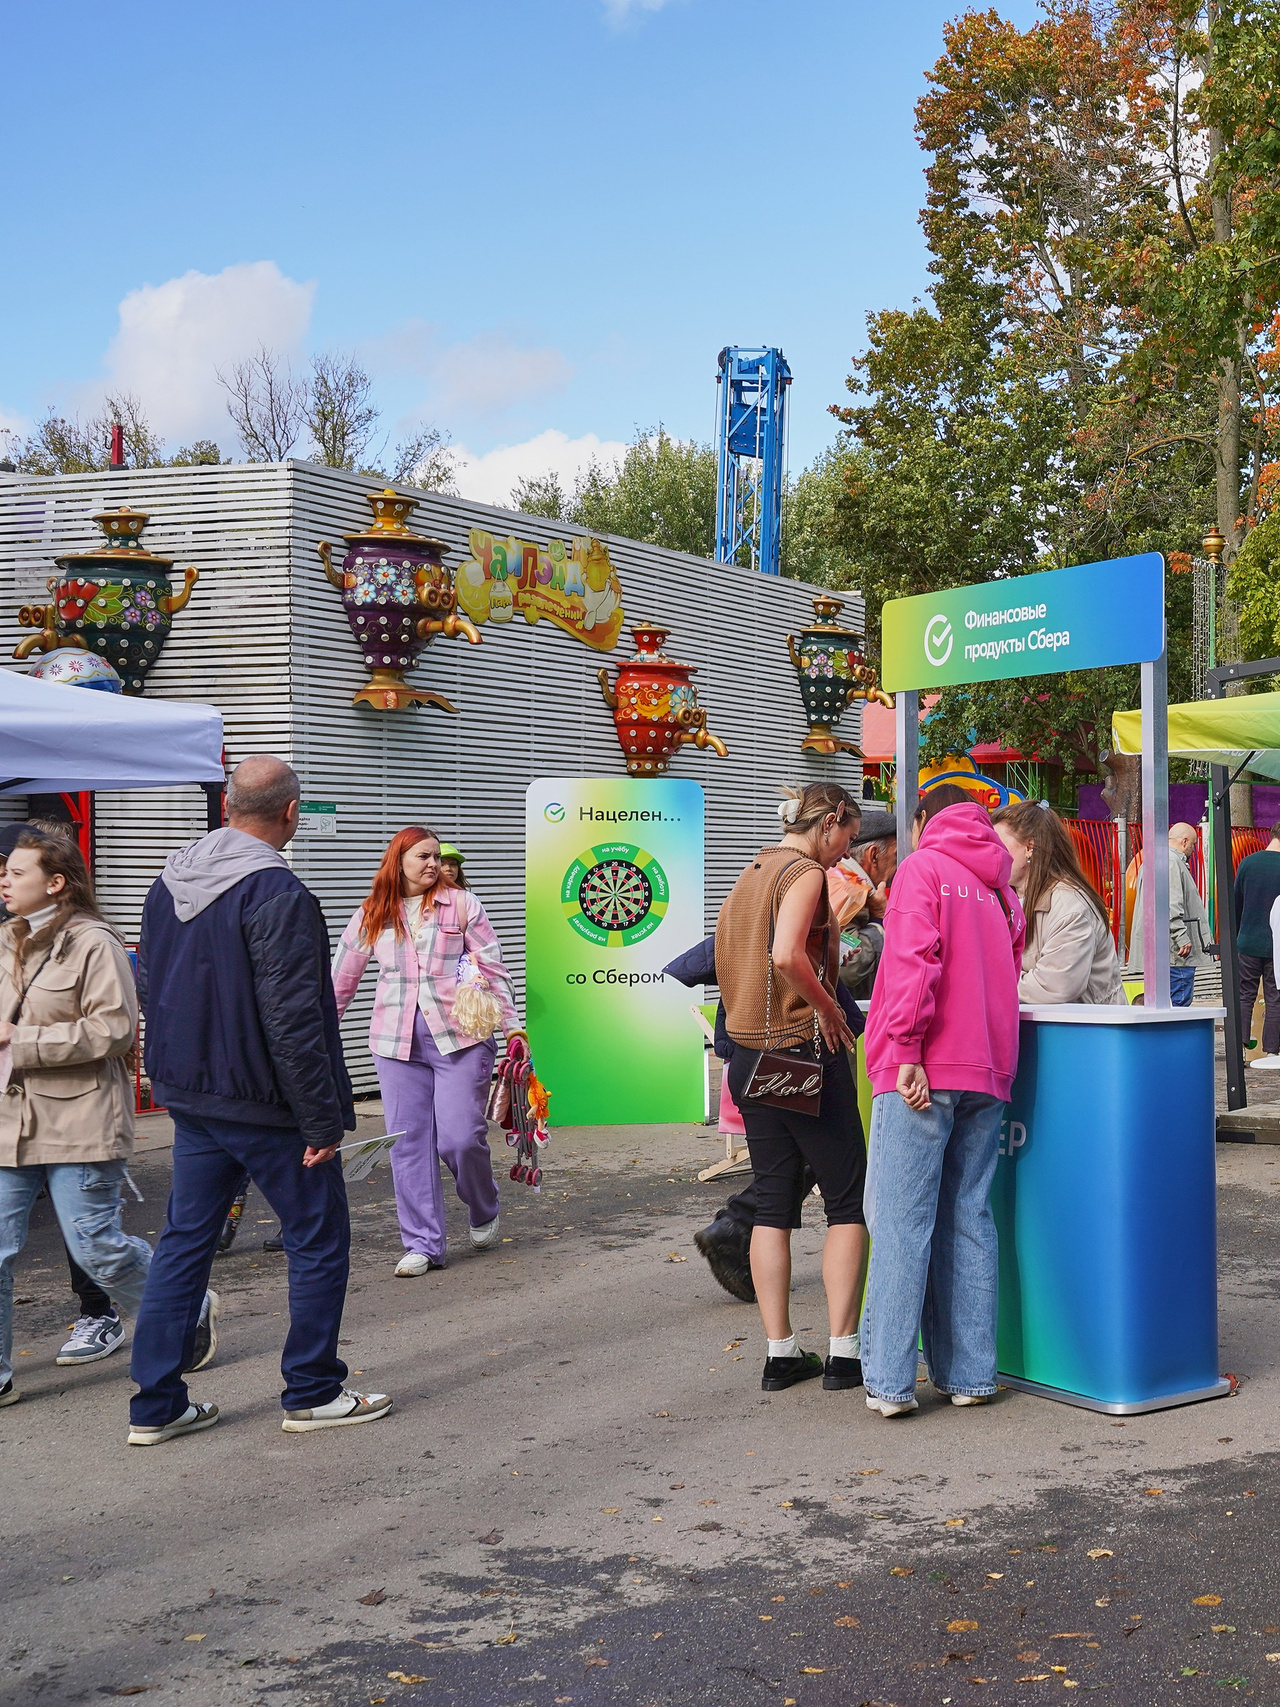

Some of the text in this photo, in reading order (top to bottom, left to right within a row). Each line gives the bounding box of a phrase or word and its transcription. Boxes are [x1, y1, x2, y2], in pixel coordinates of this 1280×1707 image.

[964, 603, 1047, 630] Финансовые
[964, 627, 1070, 663] продукты Сбера
[579, 806, 682, 824] Нацелен...
[610, 845, 630, 854] учёбу
[566, 865, 581, 890] карьеру
[573, 917, 598, 939] результат
[565, 968, 665, 988] со Сбером
[748, 1071, 821, 1099] Karl
